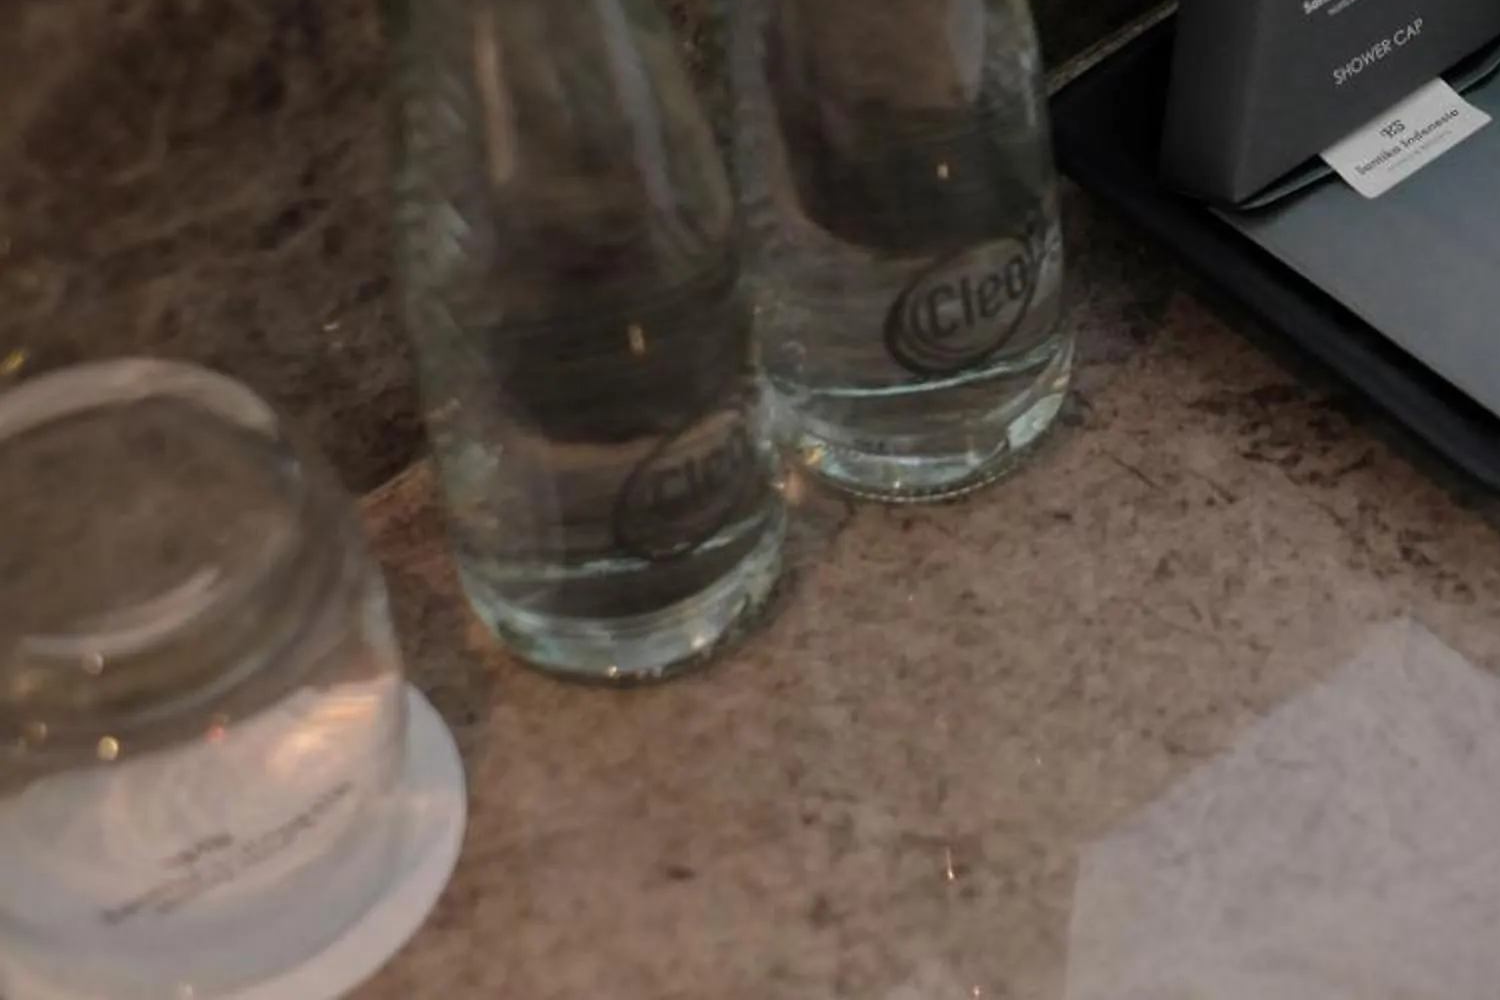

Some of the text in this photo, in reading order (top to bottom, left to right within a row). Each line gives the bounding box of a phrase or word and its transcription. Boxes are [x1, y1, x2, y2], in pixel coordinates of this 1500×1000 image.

[1332, 17, 1424, 86] SHOWER CAP
[1354, 144, 1401, 176] Santika
[1400, 108, 1460, 148] Indonesia
[925, 252, 1028, 338] Cleo
